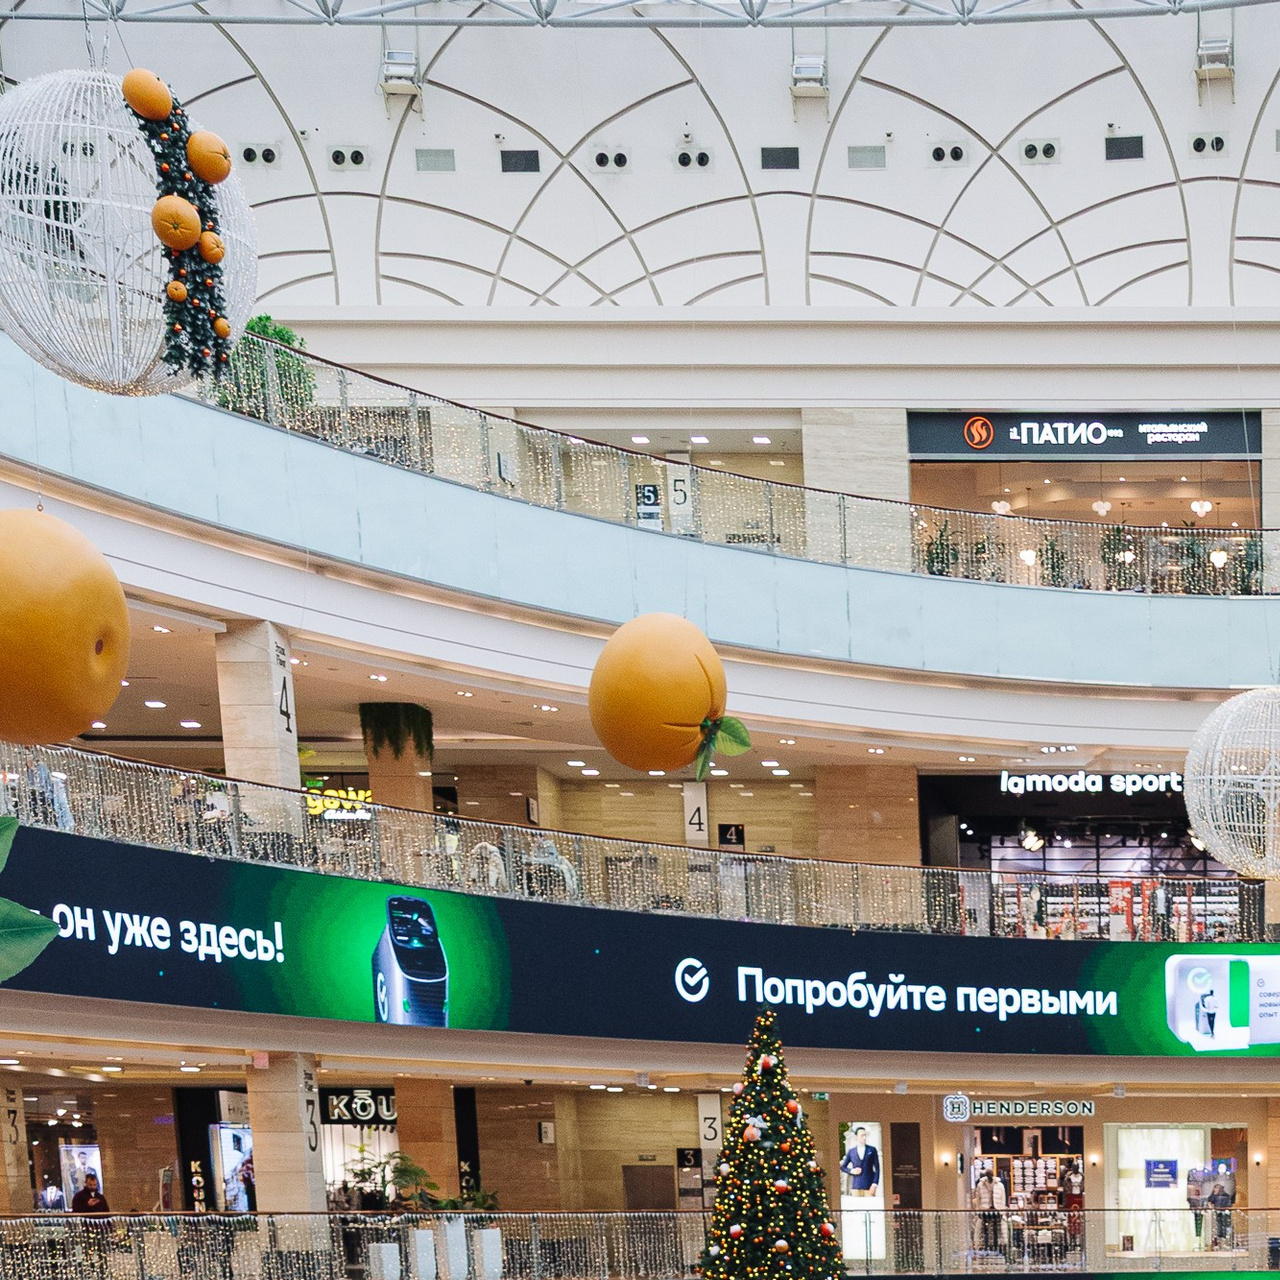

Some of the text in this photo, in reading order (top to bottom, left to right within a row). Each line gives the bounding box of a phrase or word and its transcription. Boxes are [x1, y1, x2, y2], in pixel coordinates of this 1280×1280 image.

[1020, 421, 1108, 445] ПАТИО
[672, 478, 687, 505] 5
[279, 676, 293, 734] 4
[1000, 770, 1184, 796] lamoda sport
[688, 806, 705, 832] 4
[726, 826, 737, 843] 4
[52, 903, 285, 963] он уже здесь!
[737, 965, 1118, 1021] Попробуйте первыми
[971, 1100, 1096, 1116] HENDERSON
[7, 1109, 19, 1145] 3
[306, 1099, 318, 1152] 3
[703, 1116, 718, 1141] 3
[684, 1150, 695, 1166] 3
